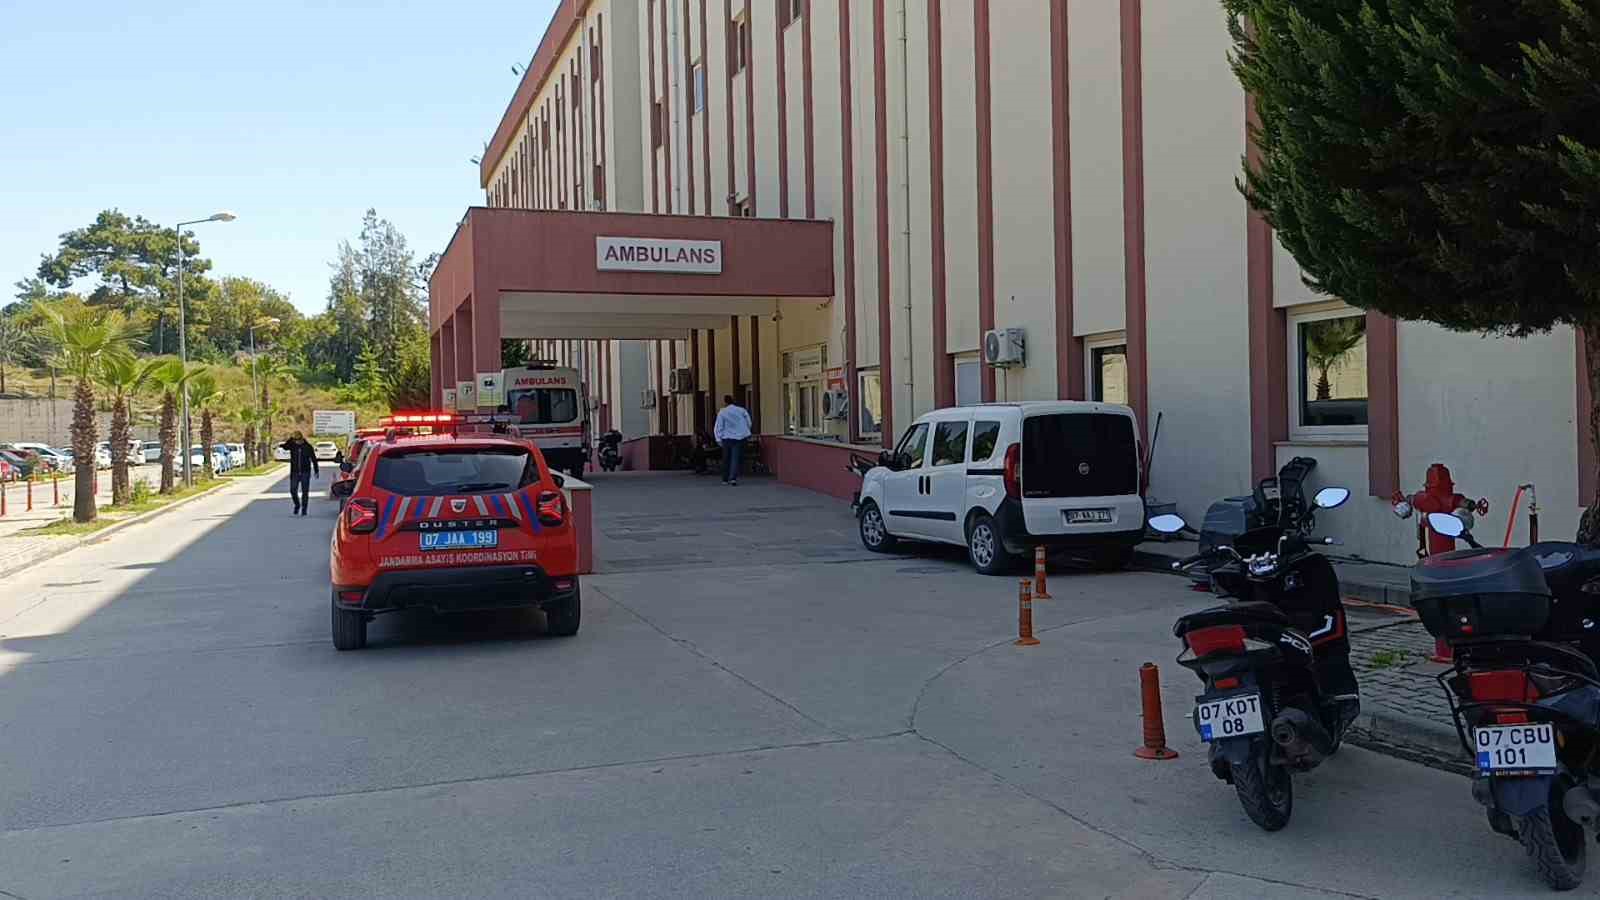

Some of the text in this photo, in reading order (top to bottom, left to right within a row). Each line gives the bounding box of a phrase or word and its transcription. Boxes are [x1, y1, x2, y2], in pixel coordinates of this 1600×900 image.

[605, 245, 715, 264] AMBULANS
[514, 376, 567, 386] AMBULANS
[420, 519, 498, 528] DUSTER
[425, 531, 493, 546] 07 JAA 199
[1201, 697, 1258, 721] 07 KDT
[1222, 718, 1244, 735] 08
[1478, 727, 1551, 747] 07 CBU
[1495, 748, 1526, 765] 101
